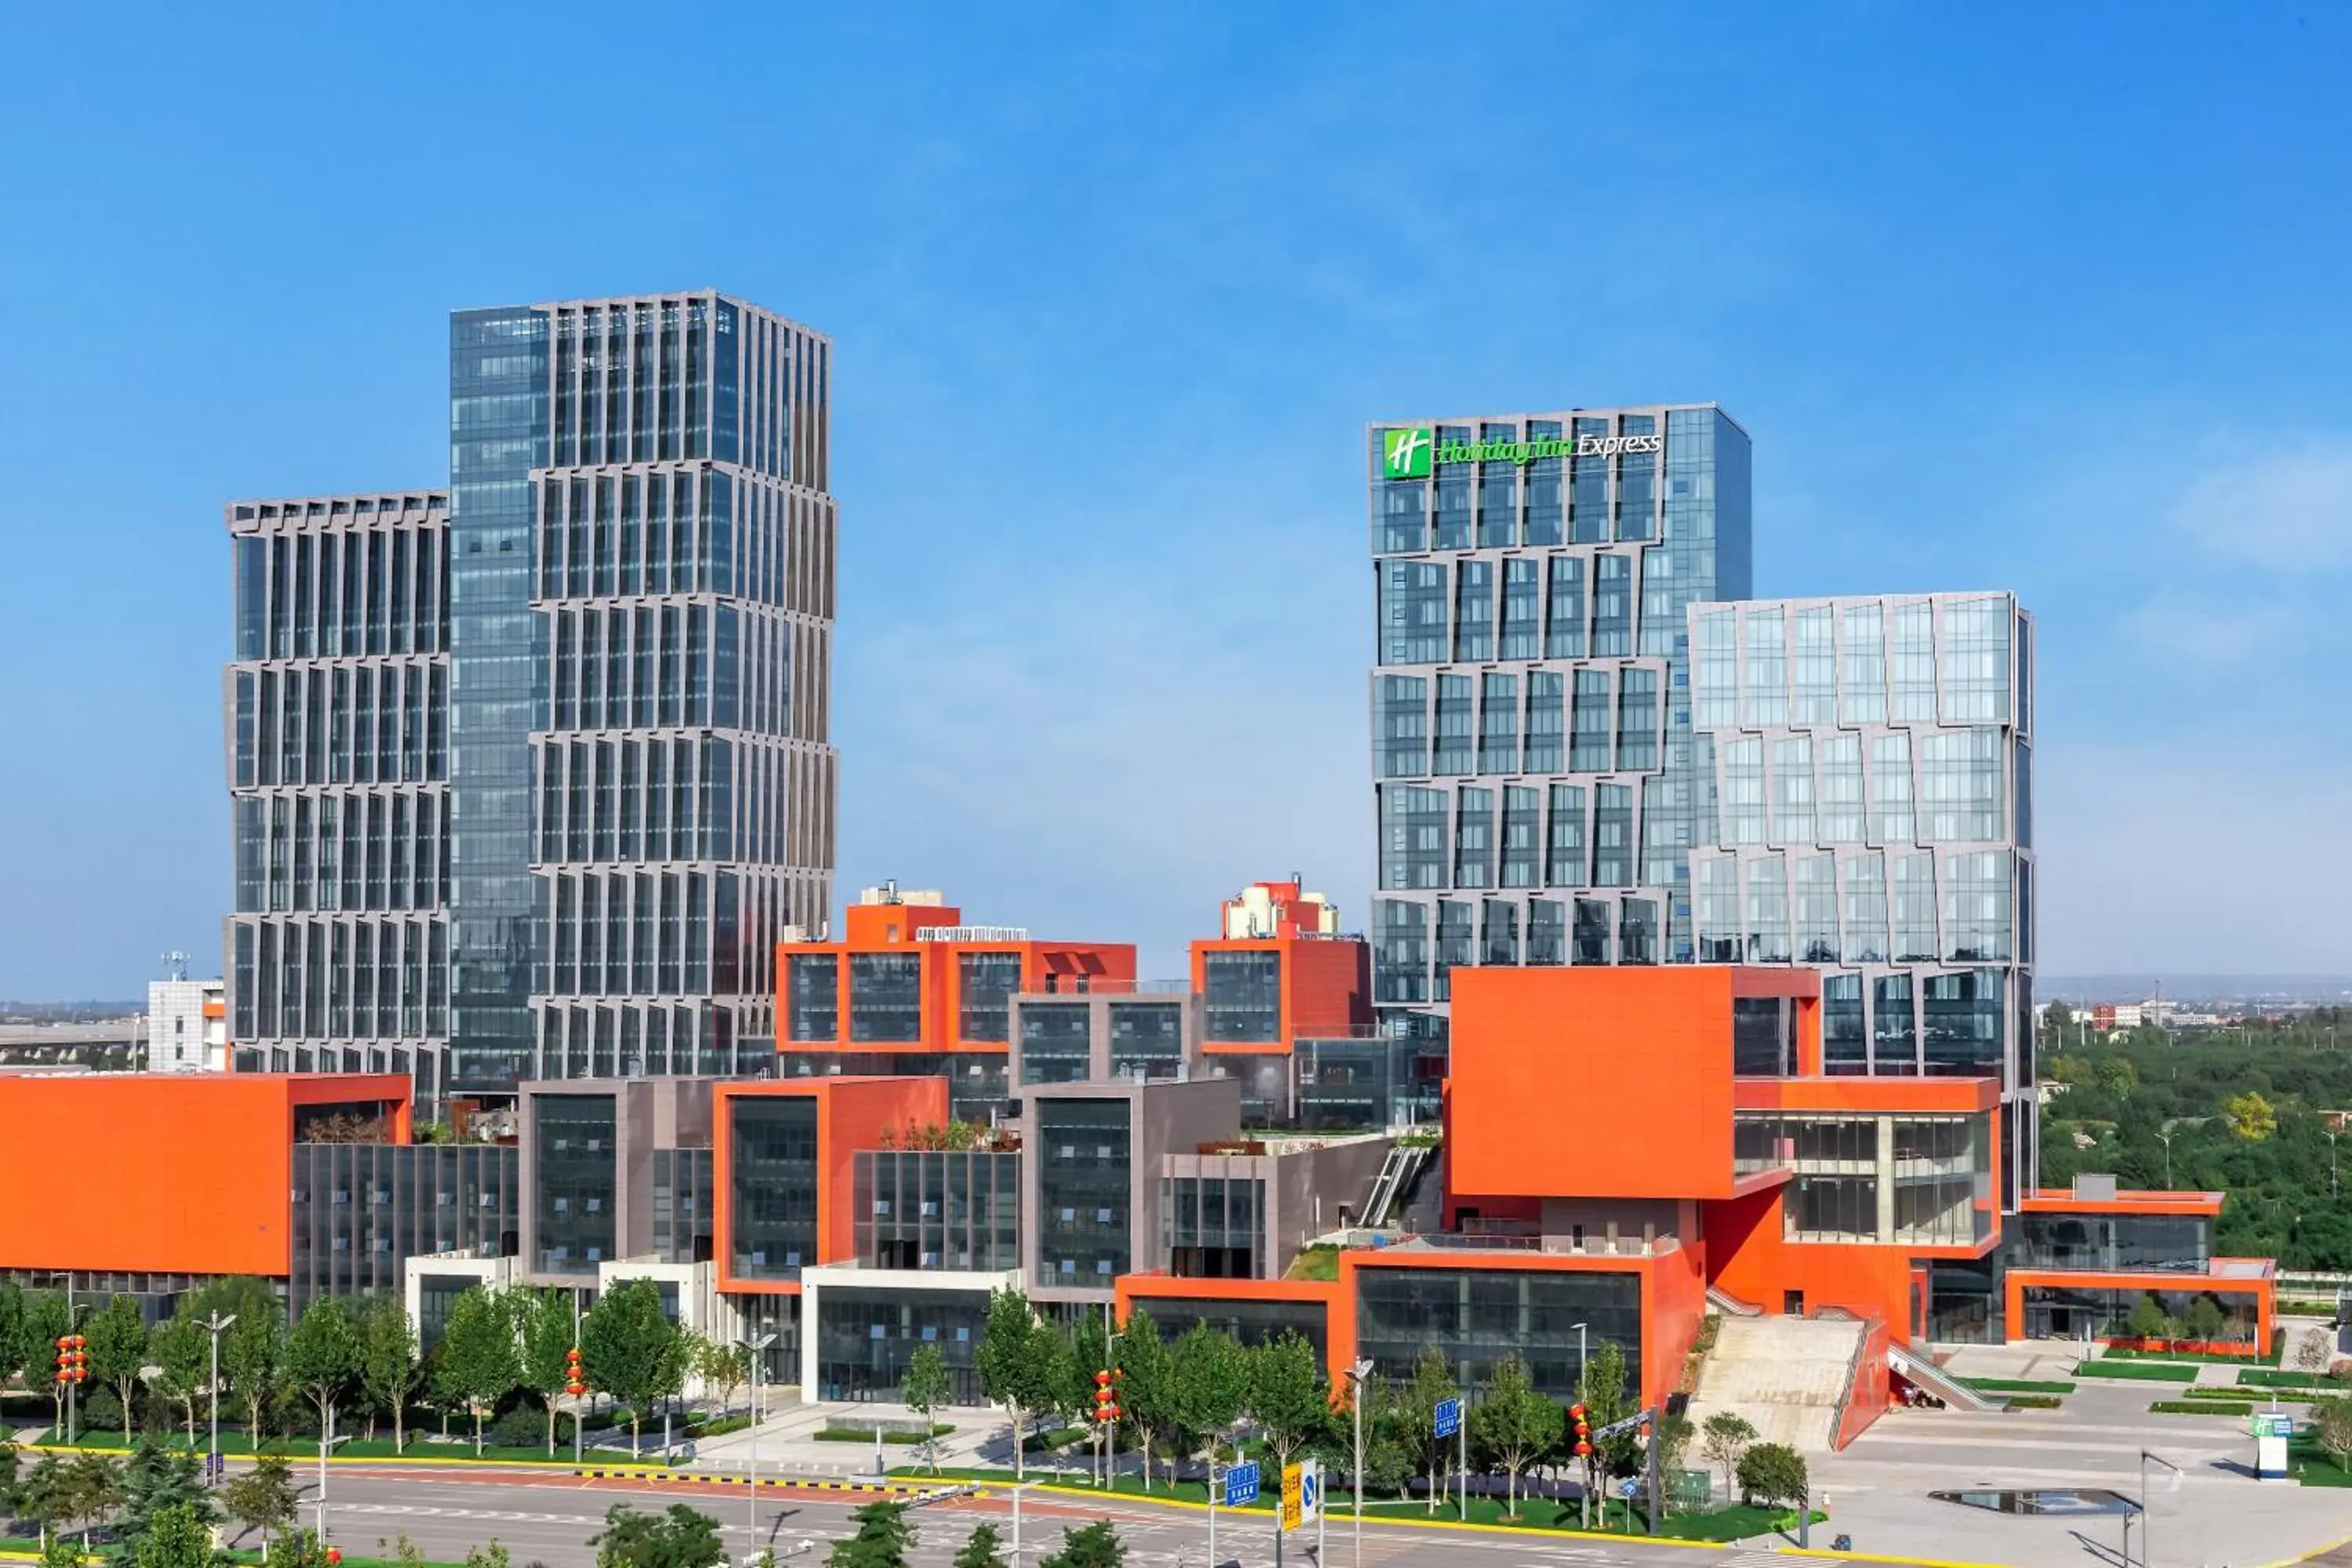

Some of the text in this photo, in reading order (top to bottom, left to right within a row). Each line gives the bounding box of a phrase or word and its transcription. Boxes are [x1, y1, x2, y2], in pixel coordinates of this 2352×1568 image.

[1438, 432, 1662, 465] Holiday Inn Express
